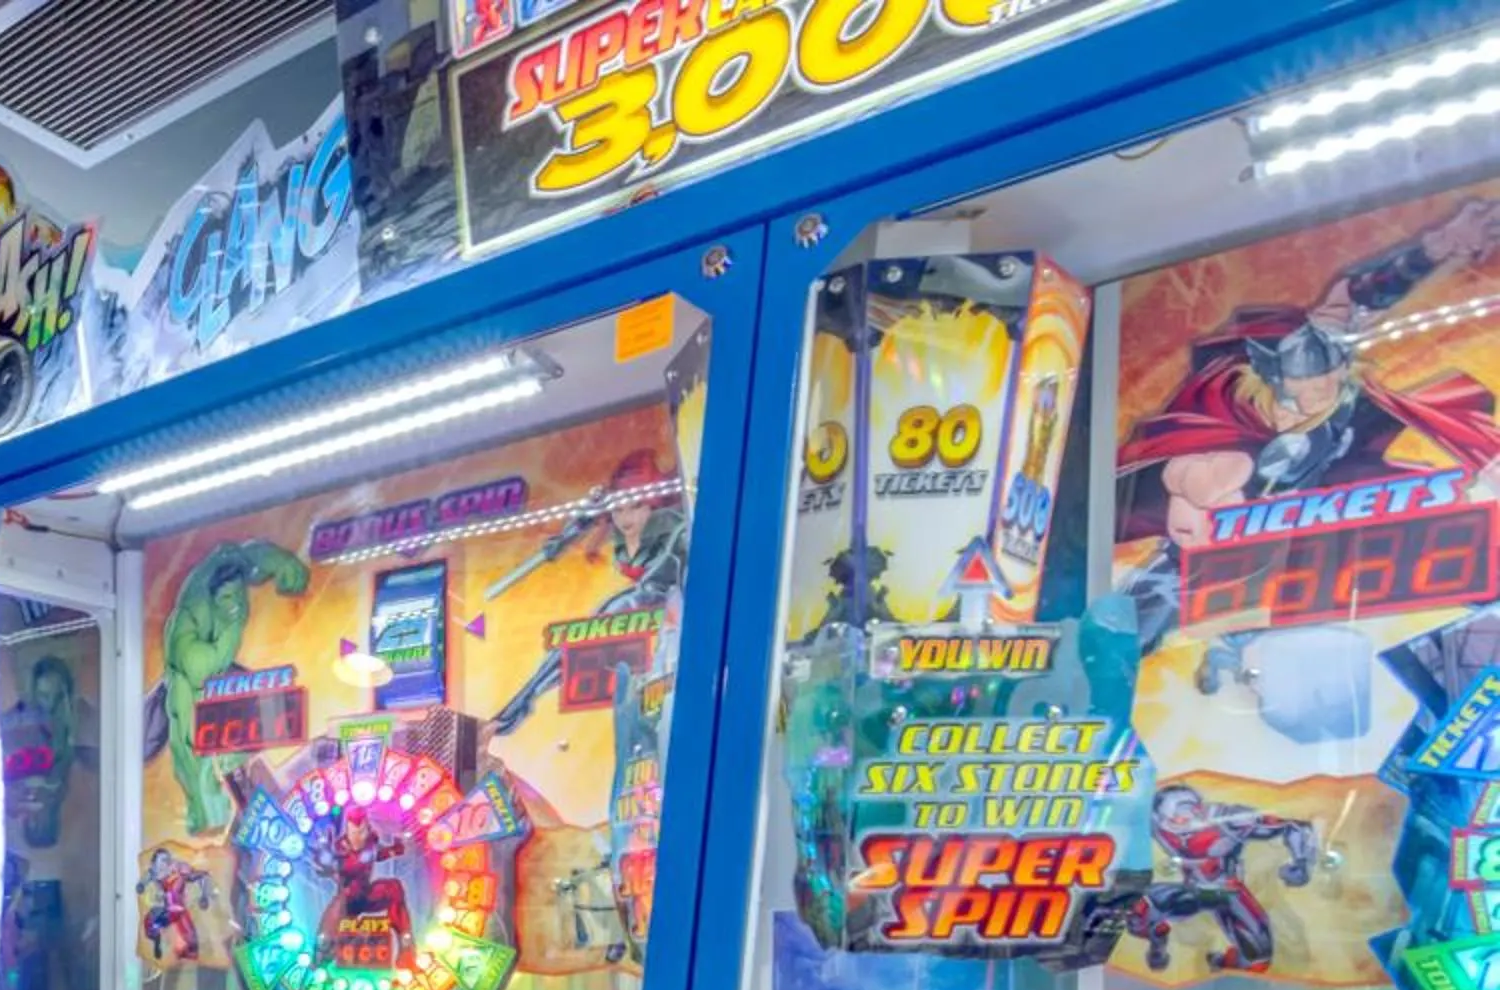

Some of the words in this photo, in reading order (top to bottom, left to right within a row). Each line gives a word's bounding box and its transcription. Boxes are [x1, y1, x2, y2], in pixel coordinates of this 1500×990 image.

[504, 0, 703, 126] SUPER
[533, 0, 1000, 192] 3,00
[889, 402, 983, 469] 80
[873, 469, 989, 498] TICKETS
[437, 480, 523, 527] SPIN
[1211, 468, 1466, 542] TICKETS
[550, 607, 665, 646] TOKENS
[899, 636, 973, 672] YOU
[976, 637, 1052, 671] WIN
[205, 666, 294, 699] TICKETS
[898, 720, 1106, 755] COLLECT
[859, 761, 947, 795] SIX
[951, 759, 1141, 795] STONES
[914, 801, 970, 829] TO
[983, 795, 1086, 829] WIN
[858, 833, 1116, 890] SUPER
[338, 917, 390, 934] PLAYS
[882, 887, 1071, 939] SPIN
